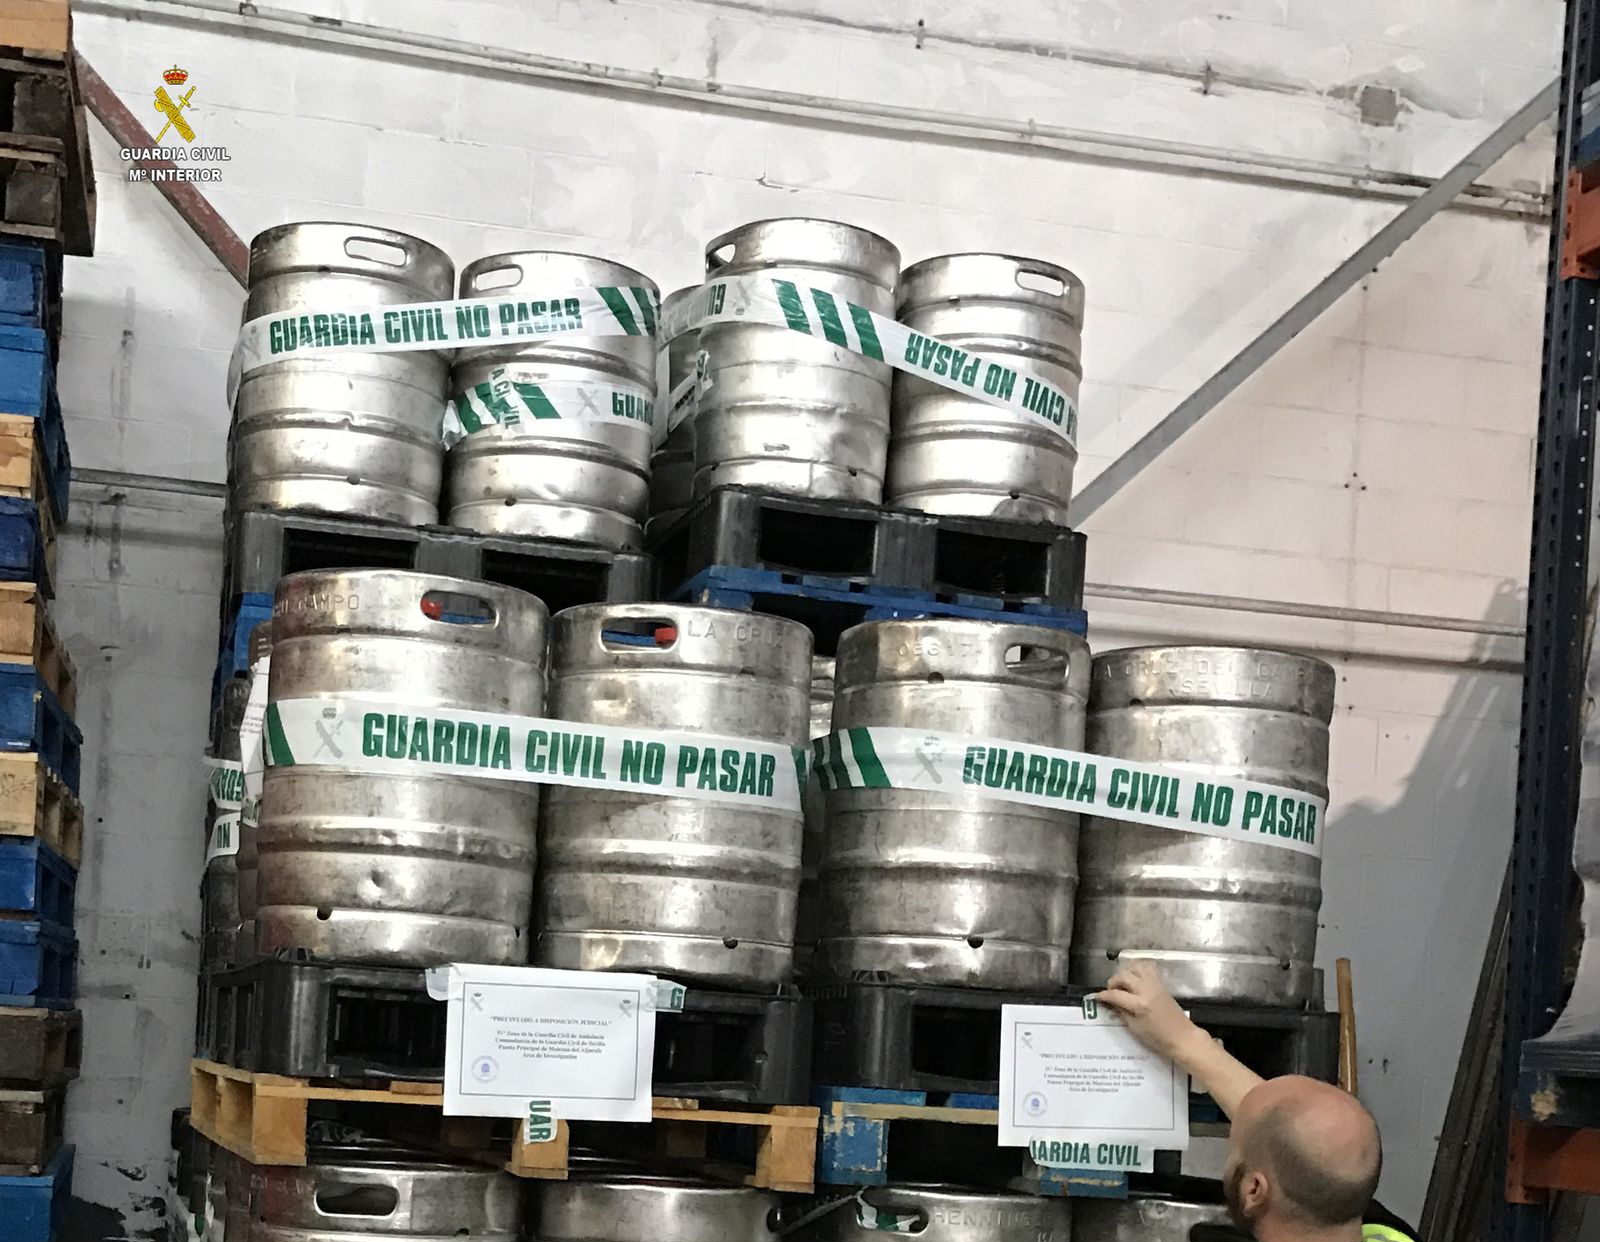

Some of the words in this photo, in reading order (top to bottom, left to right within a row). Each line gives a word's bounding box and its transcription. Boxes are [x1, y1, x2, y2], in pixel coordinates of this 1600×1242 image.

[270, 309, 374, 355] GUARDIA
[384, 304, 448, 344] CIVIL
[457, 303, 490, 339] NO
[501, 297, 583, 336] PASAR
[905, 332, 982, 389] PASAR
[984, 364, 1018, 402] NO
[1022, 376, 1066, 426] CIVIL
[362, 712, 512, 770] GUARDIA
[525, 729, 607, 781] CIVIL
[620, 740, 664, 785] NO
[676, 745, 776, 798] PASAR
[962, 744, 1097, 804] GUARDIA
[1106, 767, 1181, 820] CIVIL
[1190, 782, 1231, 827] NO
[1241, 791, 1317, 845] PASAR
[1096, 1143, 1142, 1167] CIVIL
